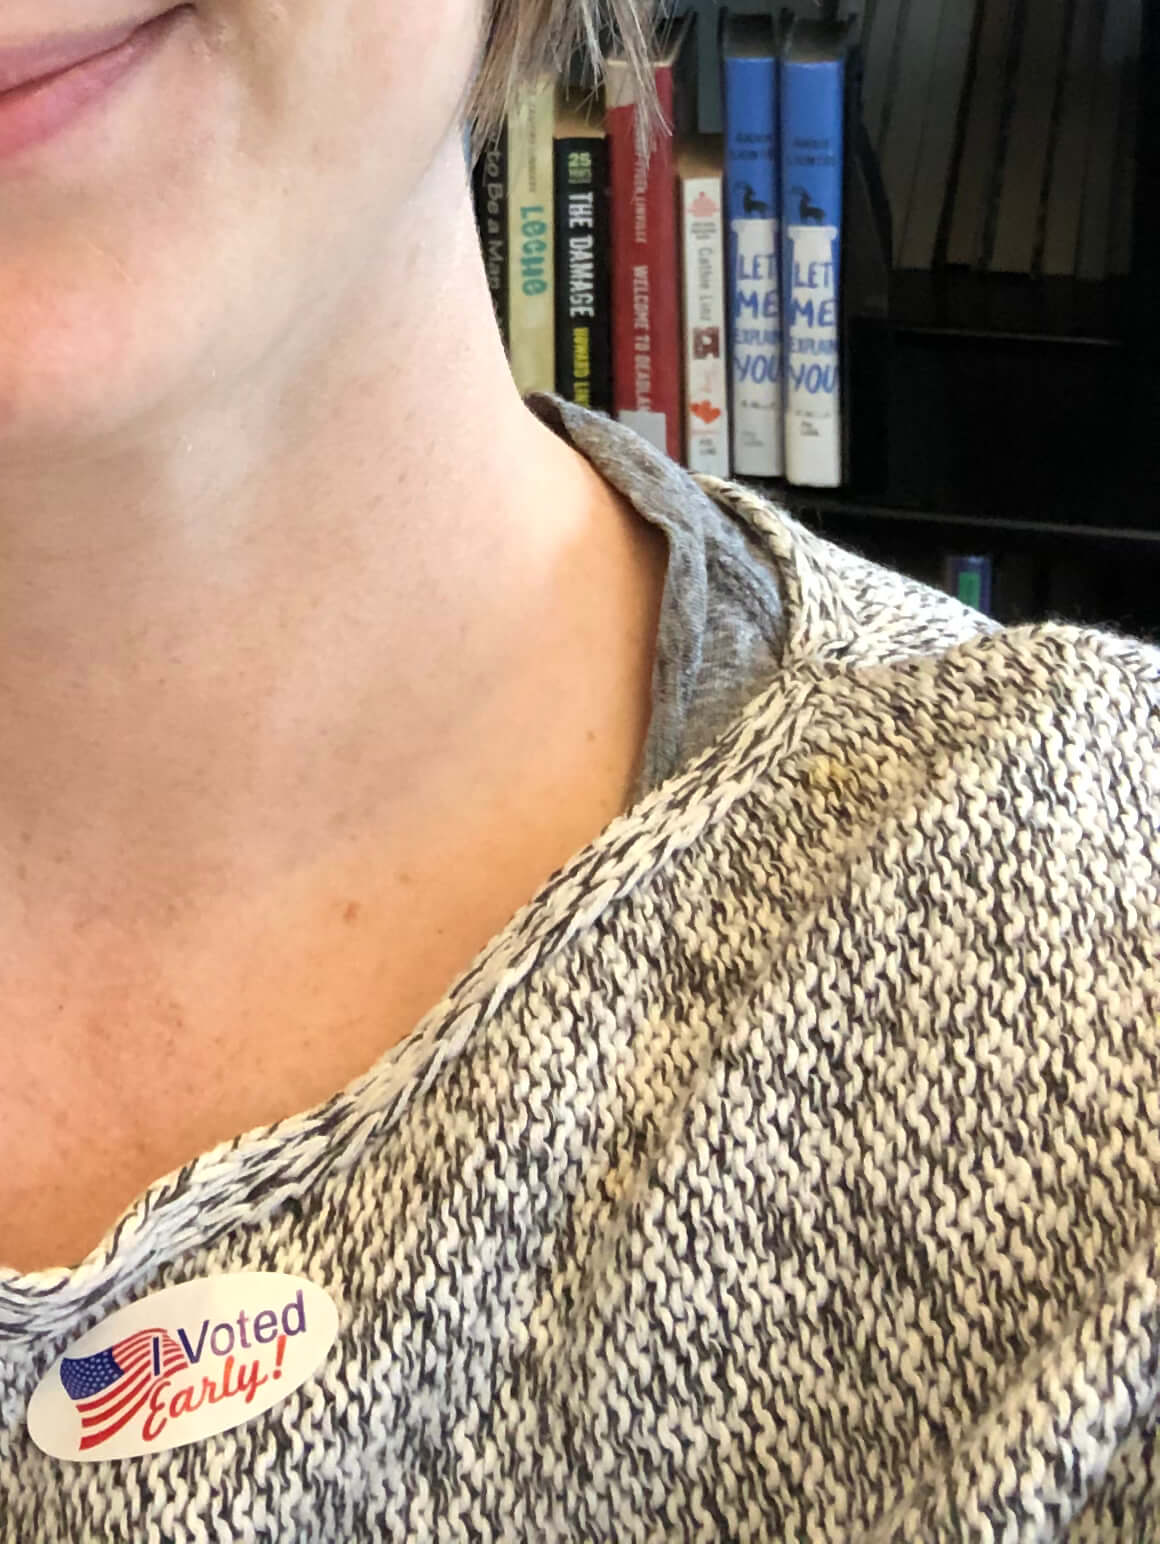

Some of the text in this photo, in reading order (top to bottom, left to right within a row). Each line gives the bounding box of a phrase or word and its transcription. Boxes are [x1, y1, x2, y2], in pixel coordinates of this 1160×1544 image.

[487, 183, 504, 215] Be
[569, 192, 595, 228] THE
[487, 219, 500, 234] a
[569, 234, 595, 318] DAMAGE
[737, 254, 776, 280] LET
[794, 260, 833, 289] LET
[633, 265, 649, 329] WELCOME
[736, 289, 778, 319] ME
[790, 297, 838, 328] ME
[634, 335, 650, 351] TO
[734, 354, 780, 384] YOU
[789, 362, 840, 394] YOU
[153, 1289, 307, 1377] I Voted
[142, 1335, 287, 1443] Early!
